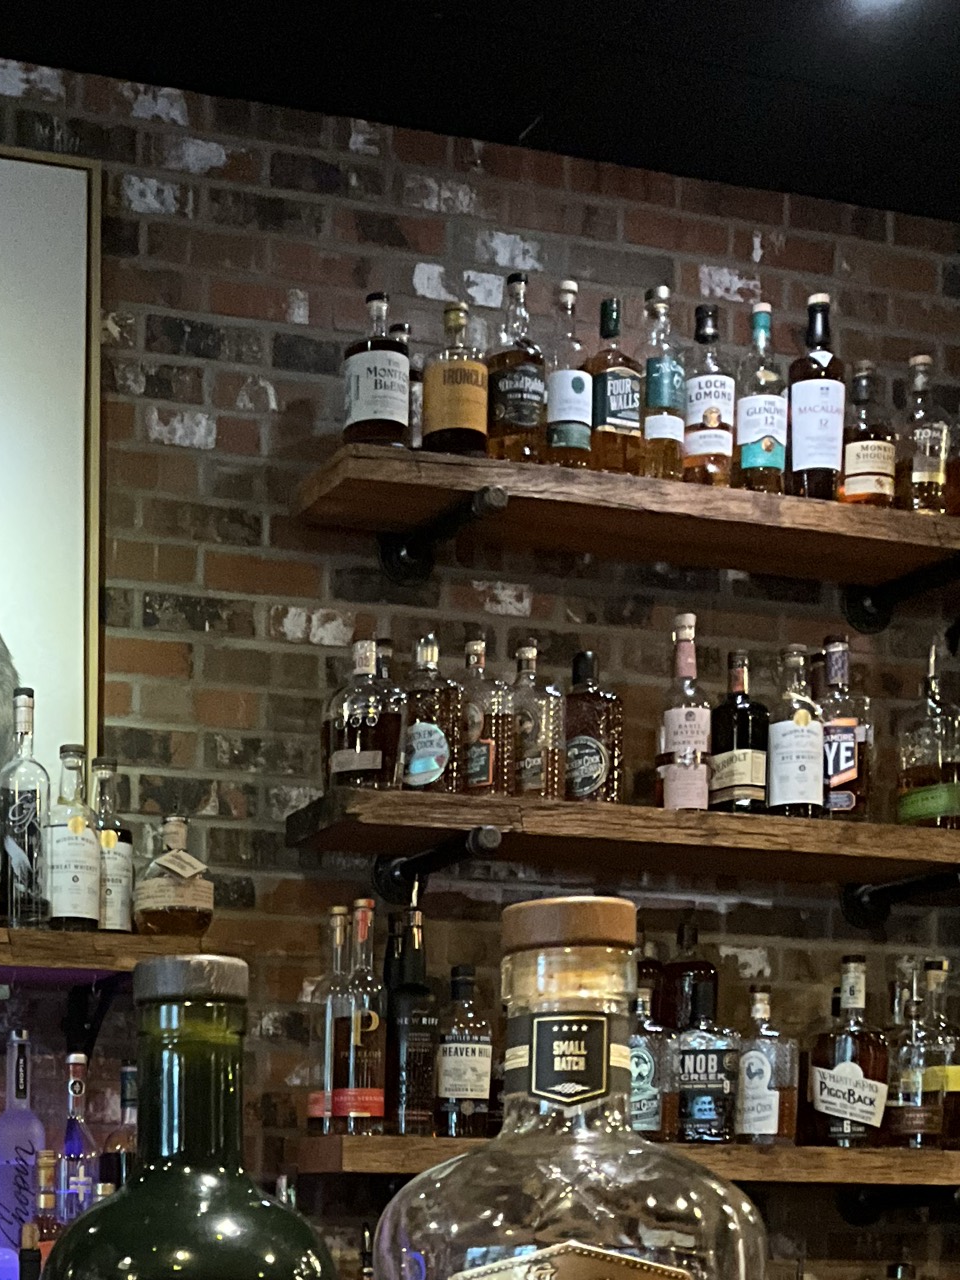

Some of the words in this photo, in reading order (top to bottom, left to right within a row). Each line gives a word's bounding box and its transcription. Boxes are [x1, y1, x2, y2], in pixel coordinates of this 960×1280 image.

[607, 378, 632, 396] FOUR
[698, 380, 726, 390] LOCH
[610, 392, 640, 411] WALLS
[689, 391, 732, 403] LOMOND
[765, 416, 775, 426] 12
[819, 418, 829, 427] 12
[849, 986, 855, 996] 6
[353, 1010, 380, 1047] P
[442, 1047, 476, 1057] HEAVEN
[553, 1040, 588, 1055] SMALL
[553, 1056, 586, 1071] BATCH
[673, 1054, 718, 1073] KNOB
[723, 1080, 730, 1094] 9
[843, 1120, 851, 1133] 6
